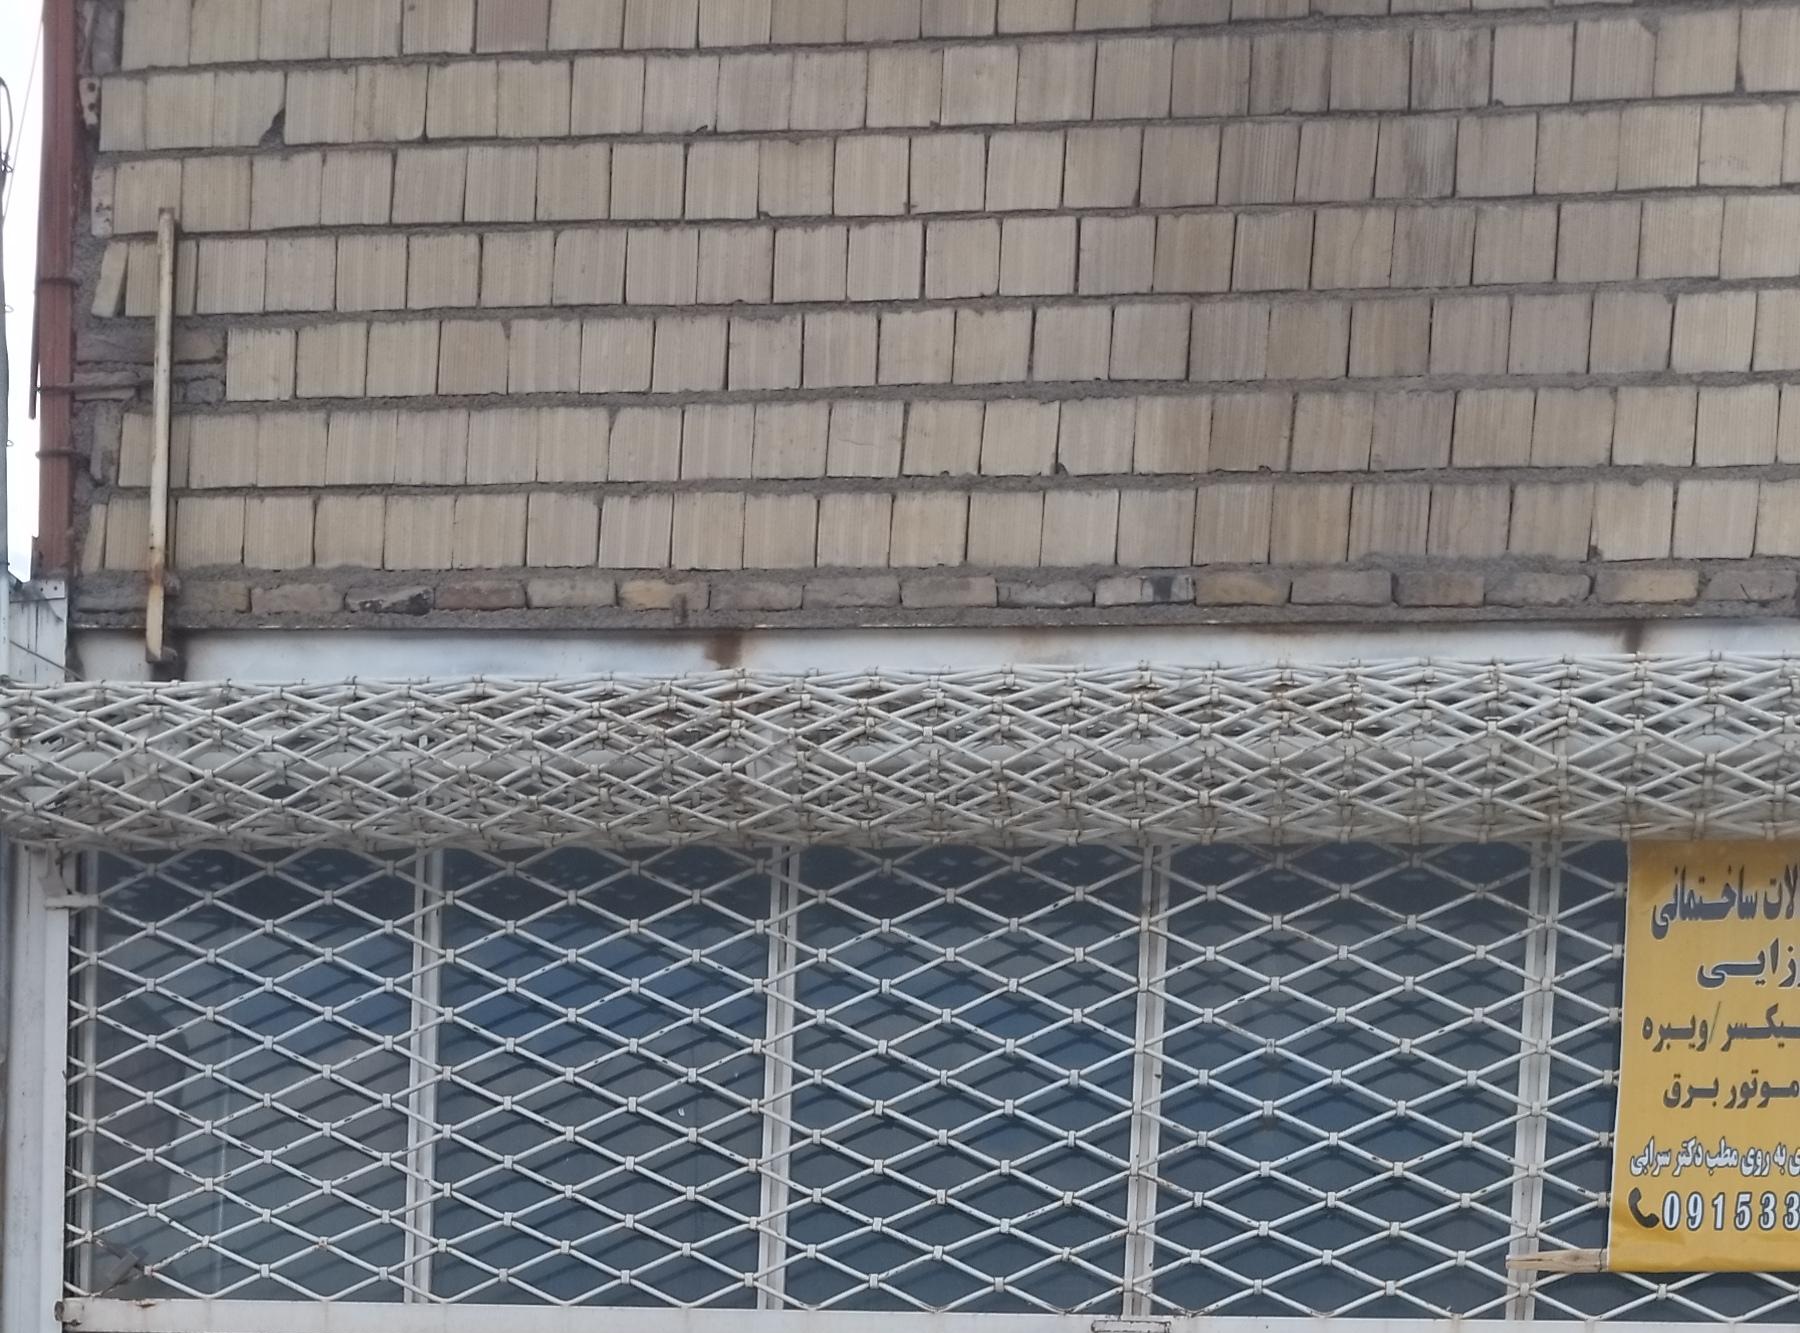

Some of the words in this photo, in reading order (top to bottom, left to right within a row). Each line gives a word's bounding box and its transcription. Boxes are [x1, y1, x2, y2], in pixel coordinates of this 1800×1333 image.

[1651, 865, 1758, 940] ساختمانی
[1698, 937, 1800, 989] زایی
[1662, 1073, 1720, 1109] برق
[1724, 1069, 1800, 1109] موتور
[1672, 1136, 1704, 1177] دکتر
[1705, 1136, 1739, 1176] مطب
[1740, 1147, 1771, 1177] روی
[1771, 1142, 1787, 1176] به
